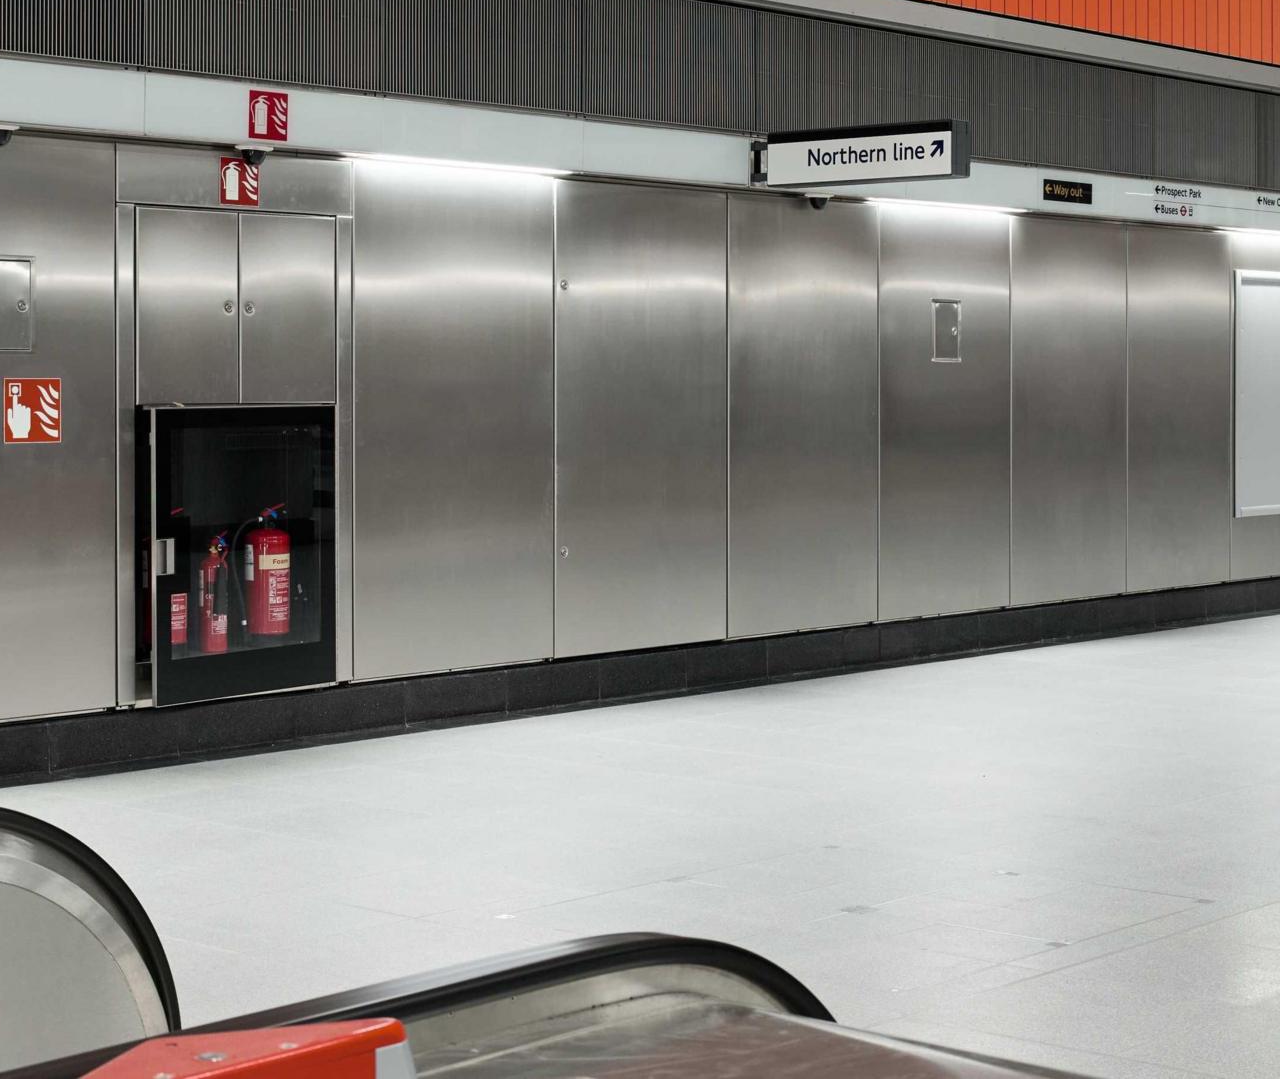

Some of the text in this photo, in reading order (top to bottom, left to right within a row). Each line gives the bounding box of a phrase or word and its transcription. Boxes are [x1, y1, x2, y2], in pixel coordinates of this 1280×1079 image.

[807, 142, 925, 167] Northern line
[1053, 184, 1083, 198] Way out
[1161, 185, 1202, 199] Prospect Park
[1263, 197, 1276, 207] New
[1161, 204, 1179, 215] Buses
